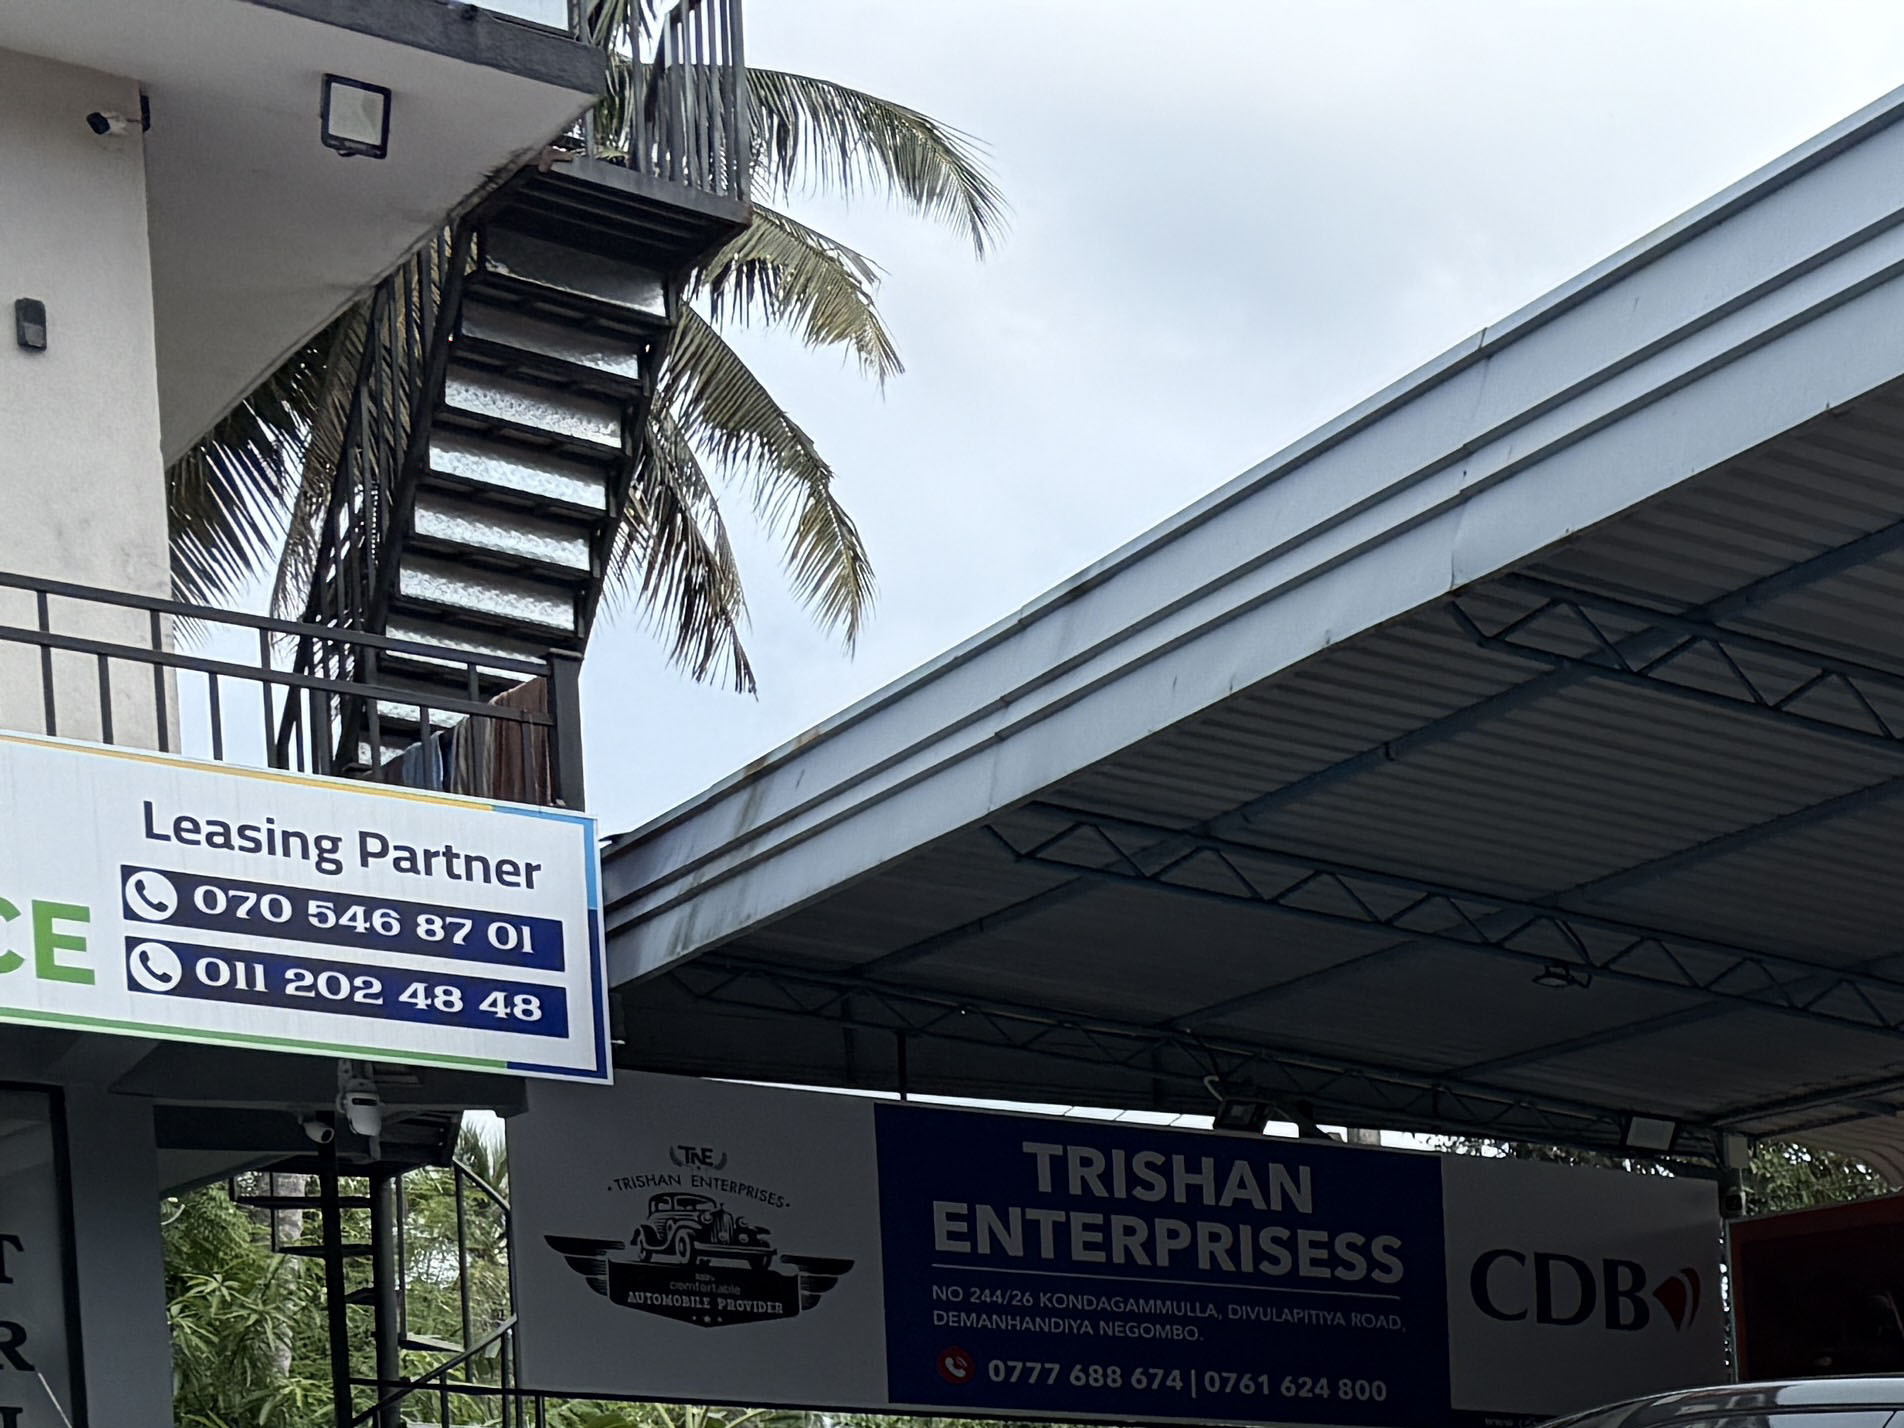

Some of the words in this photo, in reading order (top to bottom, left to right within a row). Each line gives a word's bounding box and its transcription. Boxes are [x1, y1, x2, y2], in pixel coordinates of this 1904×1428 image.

[142, 800, 344, 876] Leasing
[358, 829, 543, 890] Partner
[193, 885, 293, 924] 070
[307, 899, 401, 936] 546
[416, 914, 473, 947] 87
[486, 920, 533, 954] 01
[194, 956, 269, 993] 011
[284, 968, 384, 1006] 202
[398, 981, 464, 1014] 48
[478, 991, 543, 1022] 48
[614, 1174, 681, 1192] TRISHAN
[691, 1174, 785, 1208] ENTERPRISES
[1022, 1141, 1313, 1214] TRISHAN
[932, 1200, 1404, 1284] ENTERPRISESS
[627, 1291, 711, 1309] AUTOMOBILE
[717, 1297, 783, 1315] PROVIDER
[932, 1285, 963, 1303] NO
[969, 1286, 1034, 1308] 244/26
[1039, 1292, 1223, 1321] KONDAGAMMULLA,
[1228, 1304, 1345, 1328] DIVULAPITIYA
[1350, 1311, 1406, 1333] ROAD,
[1469, 1248, 1651, 1332] CDB
[932, 1310, 1094, 1338] DEMANHANDIYA
[1099, 1320, 1204, 1342] NEGOMBO.
[987, 1359, 1061, 1386] 0777
[1069, 1363, 1123, 1389] 688
[1131, 1367, 1184, 1391] 674
[1204, 1371, 1270, 1396] 0761
[1280, 1376, 1330, 1399] 624
[1337, 1379, 1388, 1402] 800
